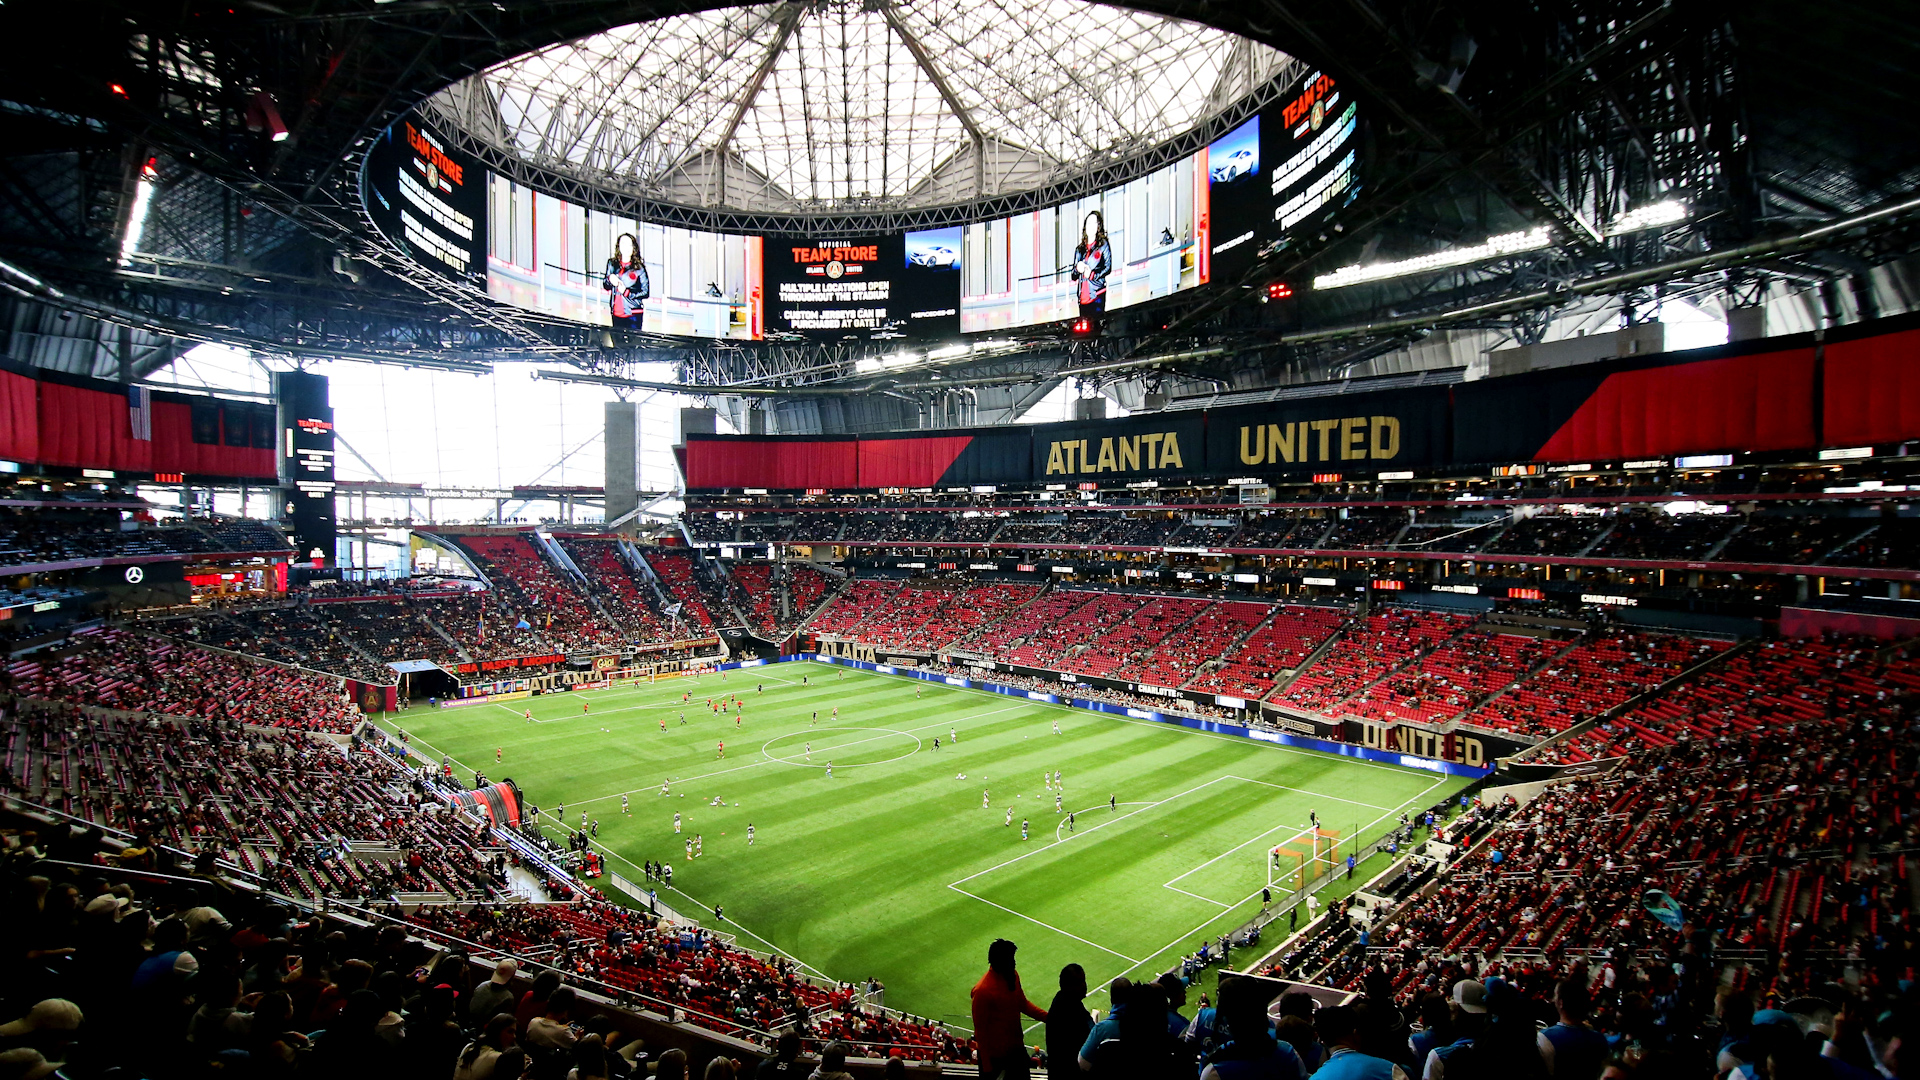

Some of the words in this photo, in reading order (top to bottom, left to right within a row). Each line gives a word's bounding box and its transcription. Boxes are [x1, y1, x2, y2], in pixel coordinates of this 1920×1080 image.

[1282, 84, 1315, 129] TEAM
[406, 121, 430, 160] TEAM
[431, 146, 463, 186] STORE
[455, 210, 473, 230] OPEN
[444, 252, 461, 271] GATE
[792, 248, 831, 263] TEAM
[834, 246, 878, 261] STORE
[780, 283, 821, 292] MULTIPLE
[822, 282, 867, 292] LOCATIONS
[868, 281, 889, 291] OPEN
[779, 292, 834, 301] THROUGHOUT
[835, 291, 851, 301] THE
[852, 290, 889, 301] STADIUM
[784, 310, 818, 320] CUSTOM
[820, 310, 856, 319] JERSEYS
[857, 309, 874, 318] CAN
[875, 308, 886, 318] BE
[791, 320, 840, 329] PURCHASED
[841, 319, 852, 328] AT
[854, 319, 875, 328] GATE
[1240, 416, 1400, 465] UNITED
[1046, 432, 1183, 475] ATLANTA
[1623, 460, 1660, 468] CHARLOTTE
[1581, 594, 1628, 605] CHARLOTTE
[1628, 598, 1638, 606] FC
[522, 654, 565, 666] ANORMAL
[978, 661, 995, 669] UNITED
[1138, 685, 1177, 697] CHARLOTTE
[777, 1062, 788, 1070] 25
